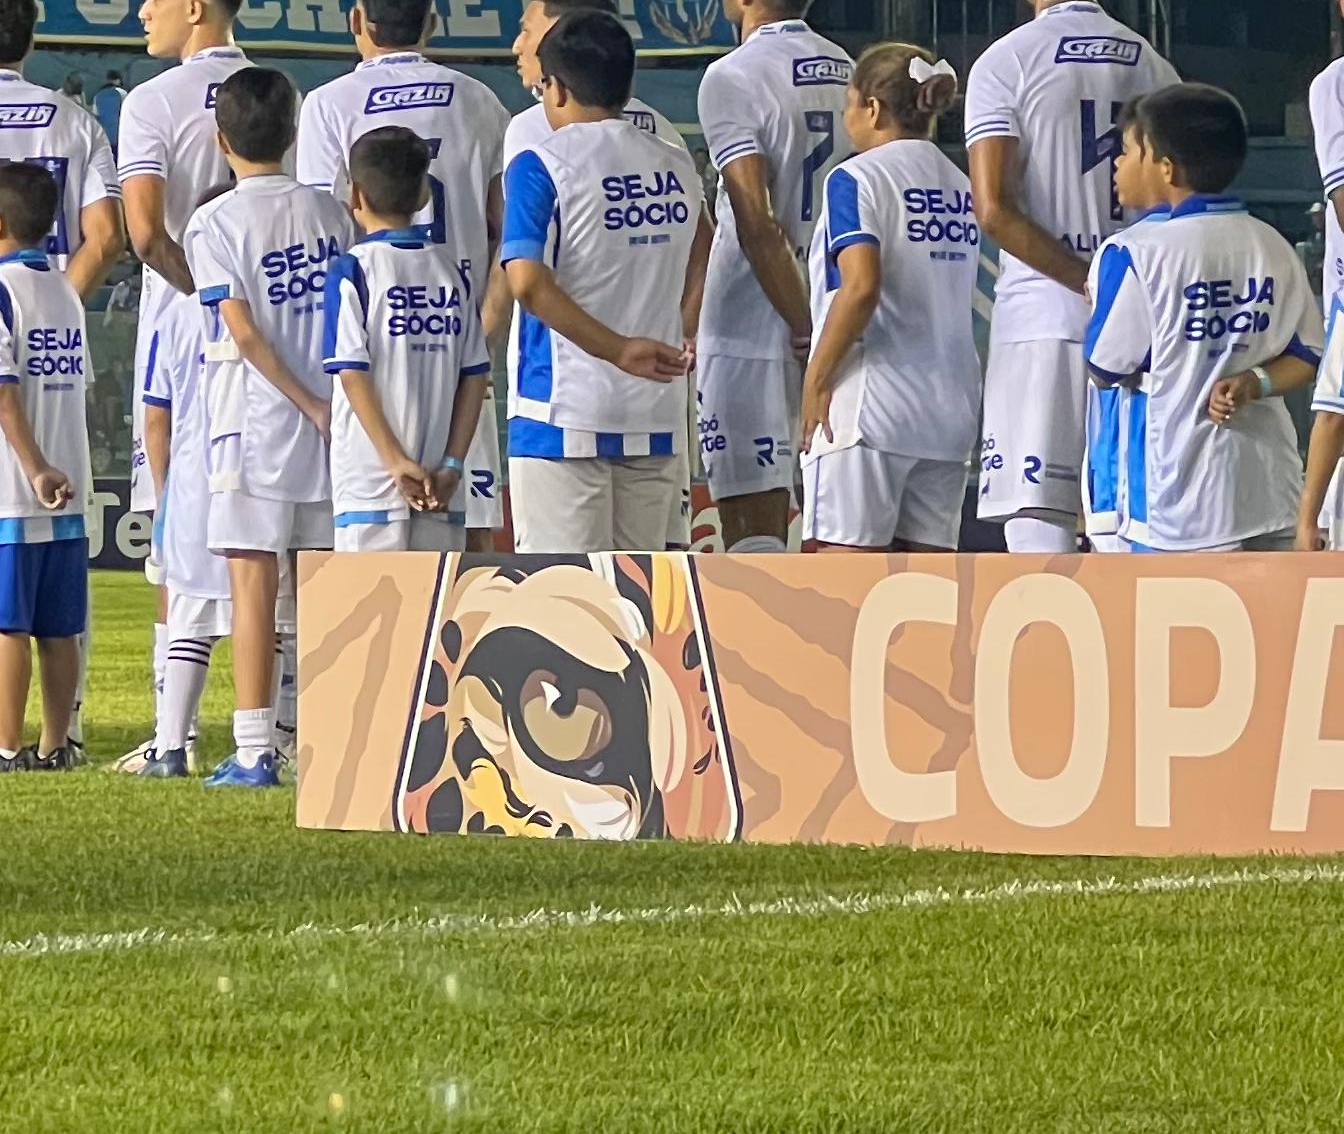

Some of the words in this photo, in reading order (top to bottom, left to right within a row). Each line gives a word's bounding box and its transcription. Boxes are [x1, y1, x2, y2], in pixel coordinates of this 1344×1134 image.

[801, 110, 834, 221] 7
[602, 171, 686, 202] SEJA
[903, 188, 974, 215] SEJA
[604, 201, 689, 231] SÓCIO
[907, 214, 978, 246] SÓCIO
[267, 270, 327, 306] SÓC
[387, 286, 461, 309] SEJA
[1183, 277, 1275, 311] SEJA
[388, 311, 462, 336] SÓCIO
[27, 328, 82, 352] SEJA
